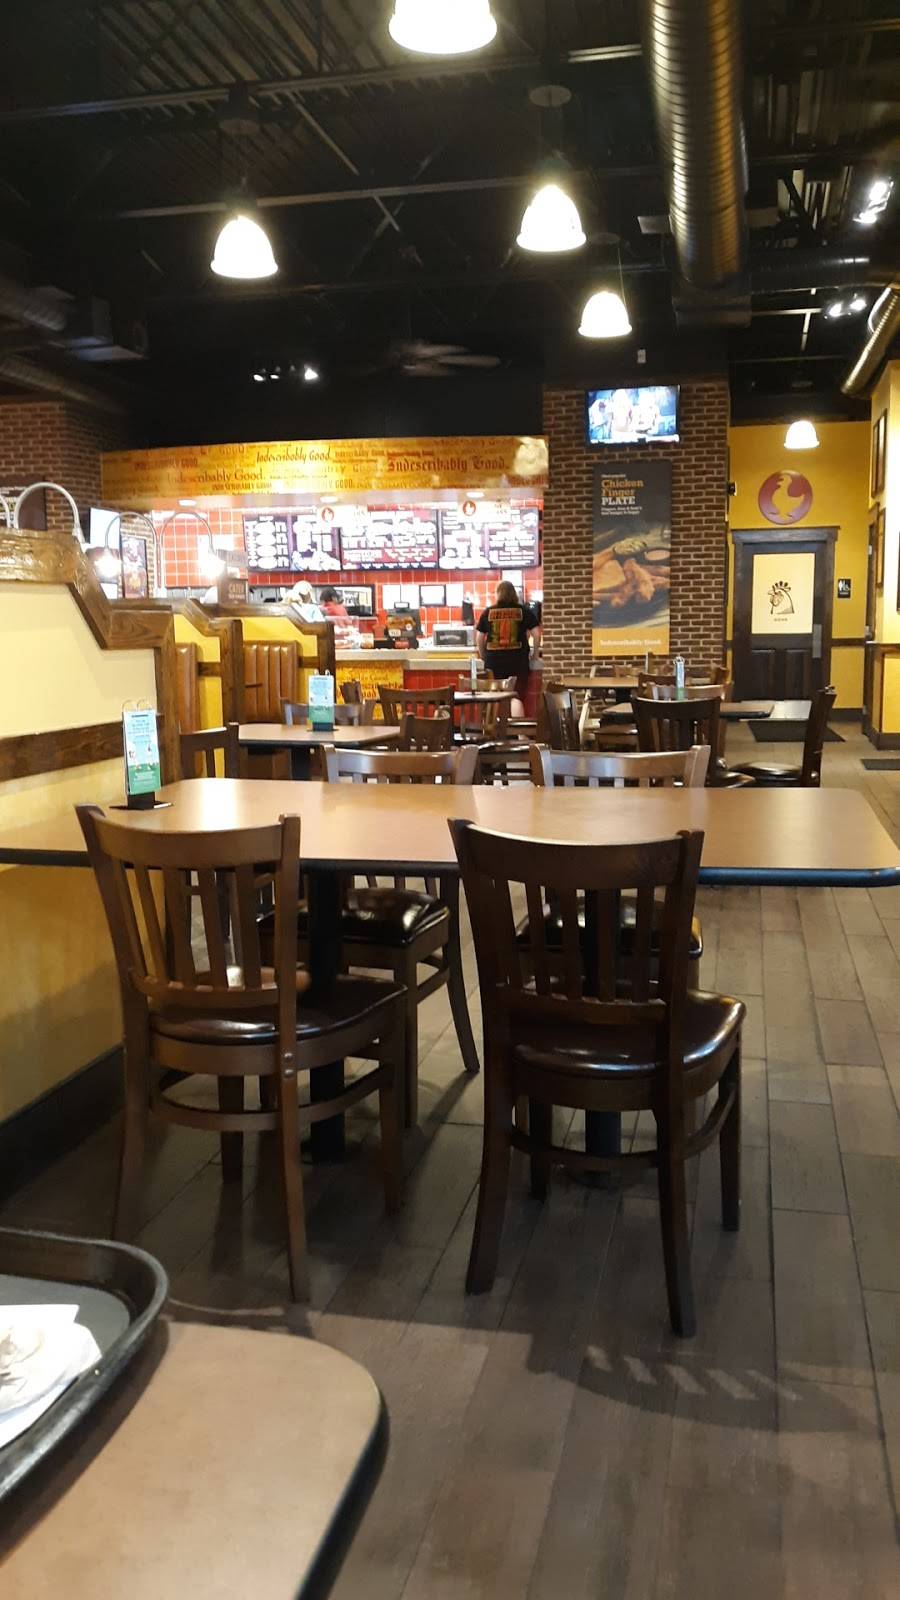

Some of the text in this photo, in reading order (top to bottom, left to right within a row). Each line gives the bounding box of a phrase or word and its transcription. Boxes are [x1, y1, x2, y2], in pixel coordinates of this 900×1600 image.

[256, 446, 307, 463] Indescribably
[387, 457, 468, 473] Indescribably
[601, 479, 645, 488] Chicken
[601, 488, 635, 500] Finger
[601, 496, 636, 506] PLATE
